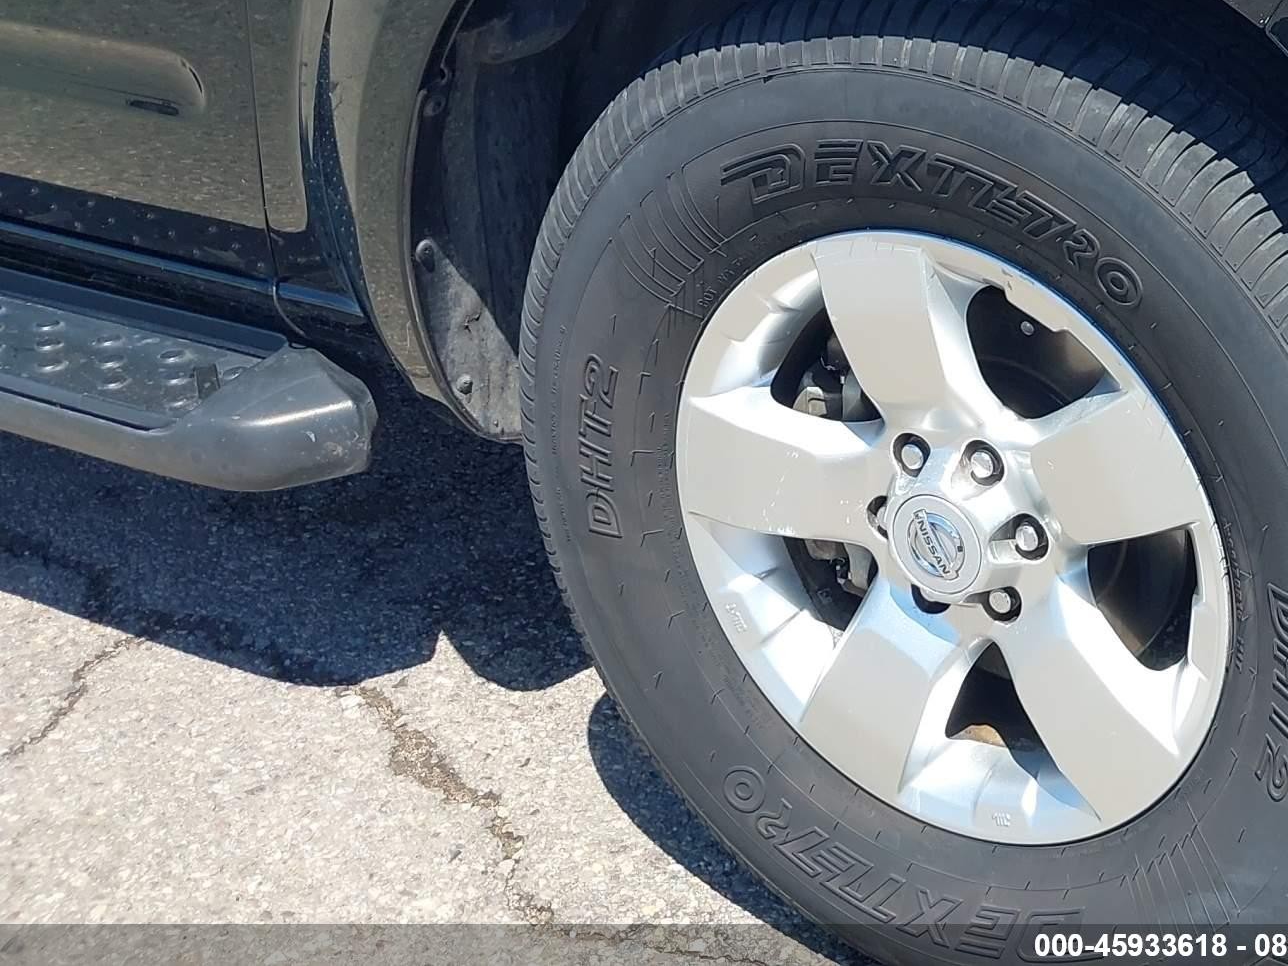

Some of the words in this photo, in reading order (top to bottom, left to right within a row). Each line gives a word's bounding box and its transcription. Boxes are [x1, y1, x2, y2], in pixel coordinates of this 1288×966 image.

[720, 138, 1145, 308] DEXTERO
[578, 353, 623, 539] DHT2
[915, 517, 951, 575] NISSAN
